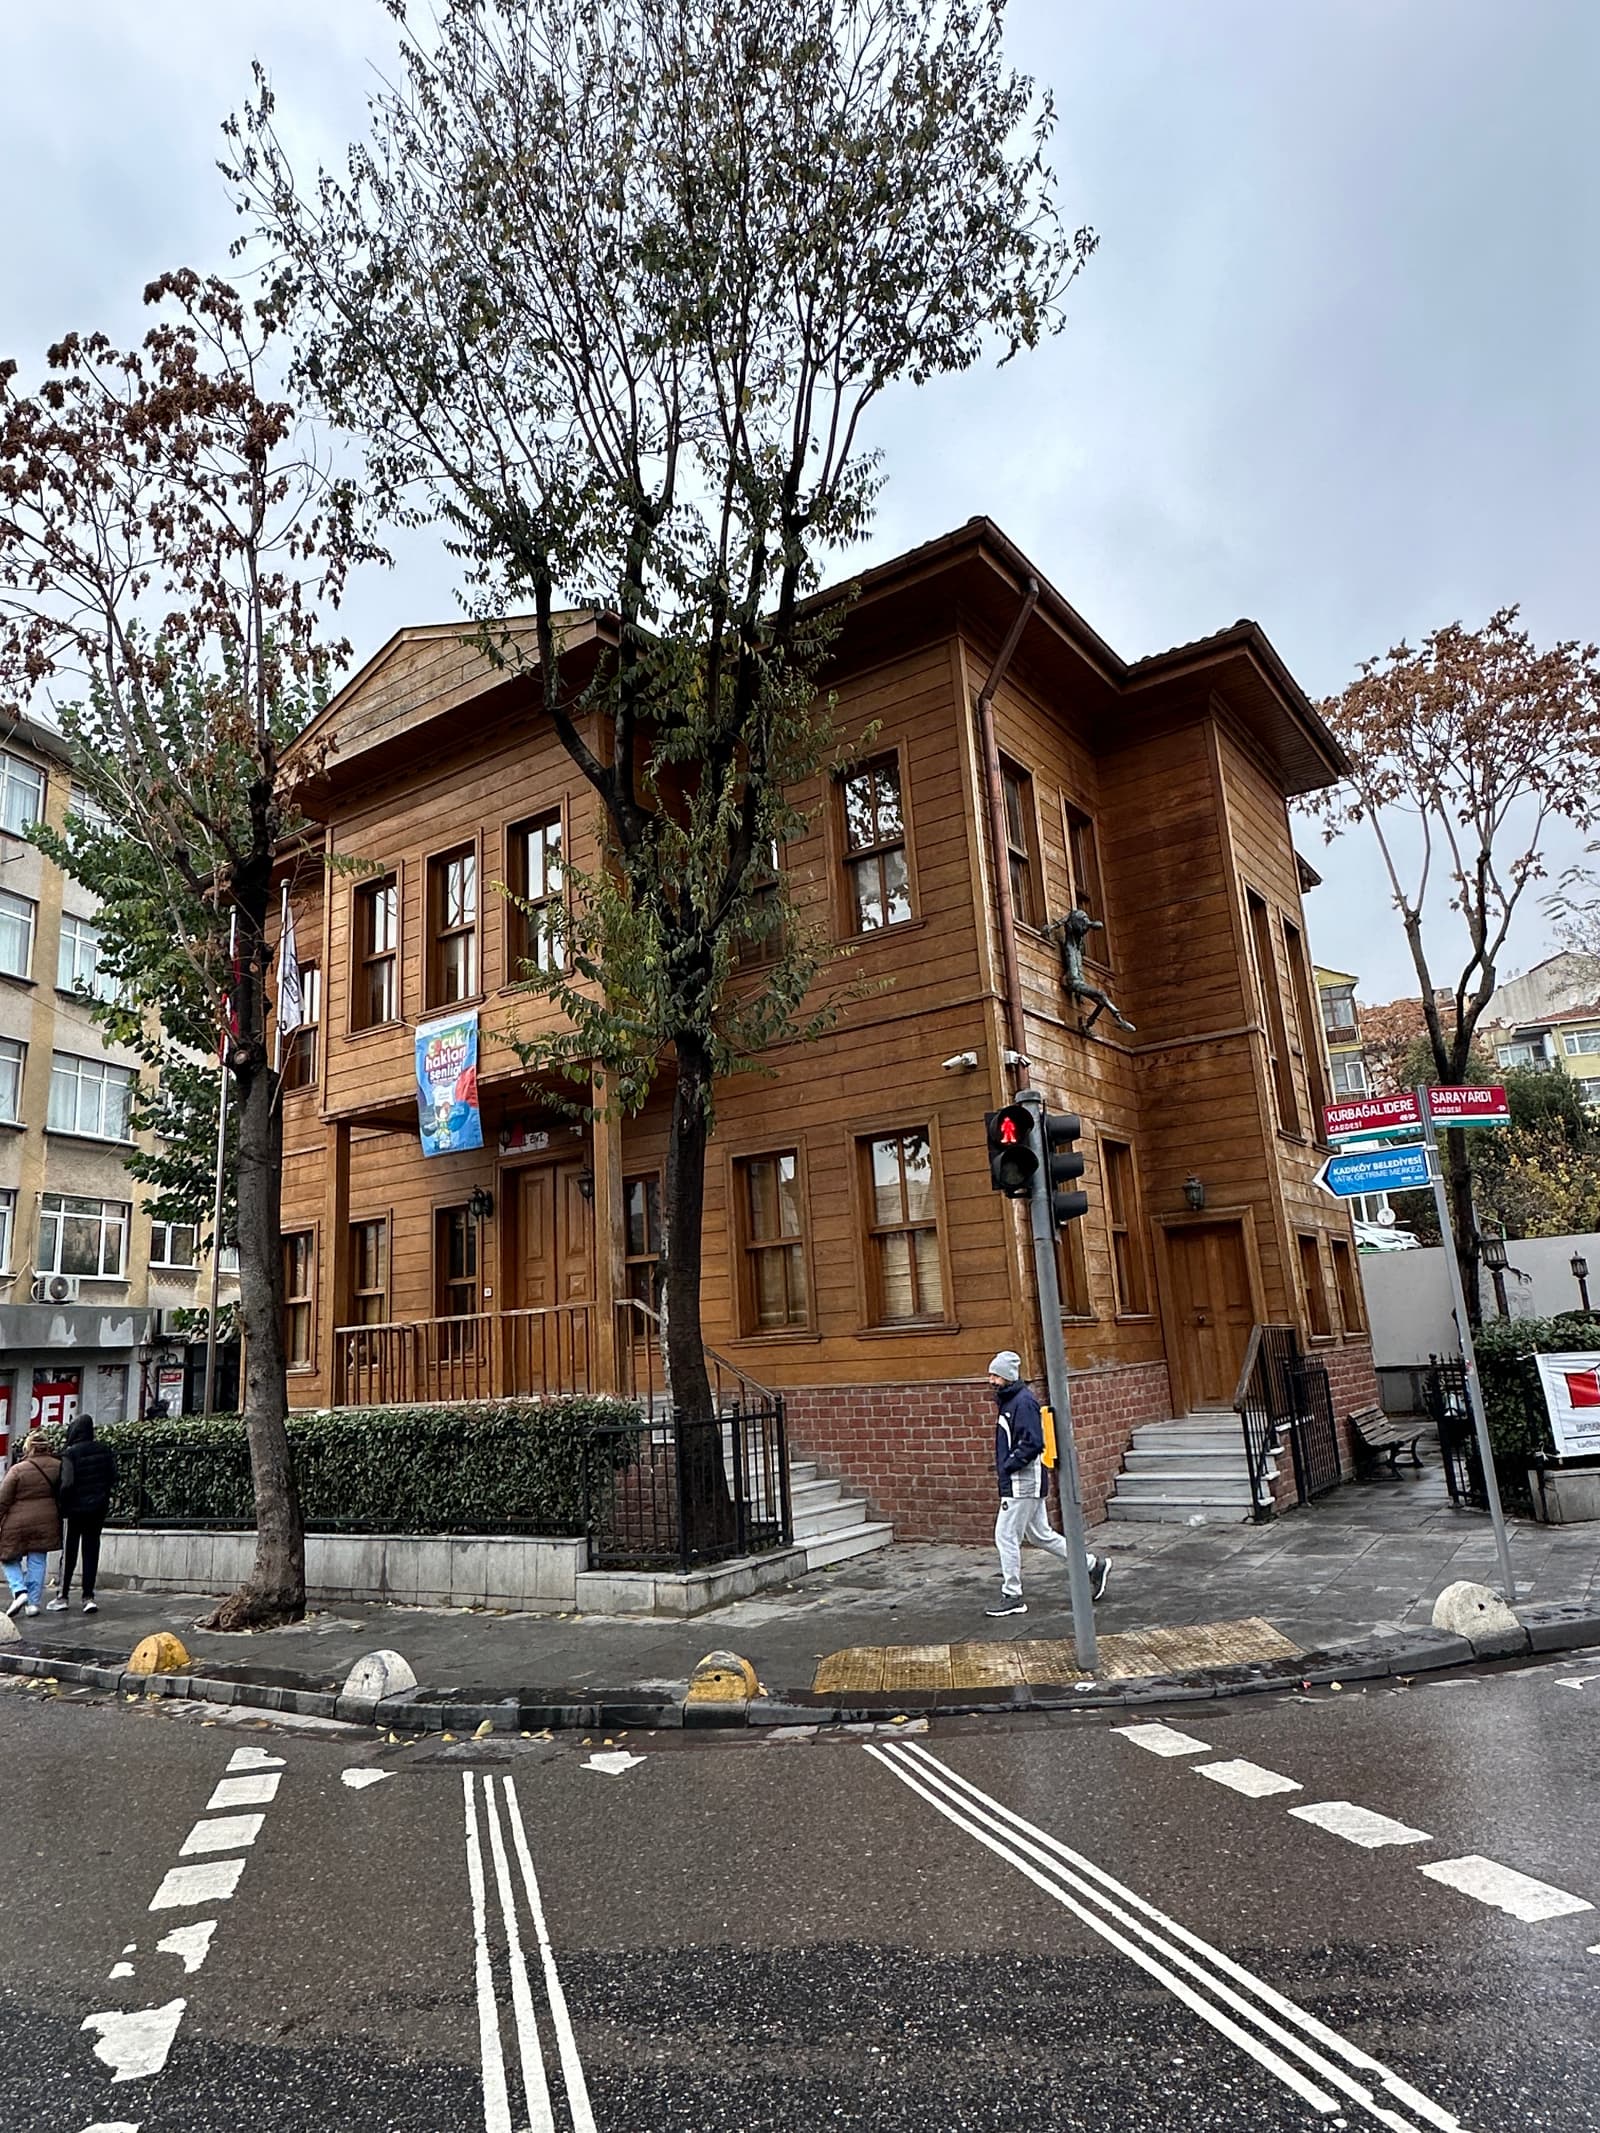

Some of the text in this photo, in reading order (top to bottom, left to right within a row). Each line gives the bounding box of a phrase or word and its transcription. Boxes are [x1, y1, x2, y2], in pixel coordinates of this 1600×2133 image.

[1431, 1090, 1492, 1104] SARAYARDI
[1327, 1099, 1415, 1123] KURBAĞALIDERE
[1333, 1154, 1422, 1176] KADIKÖY BELEDİYESİ
